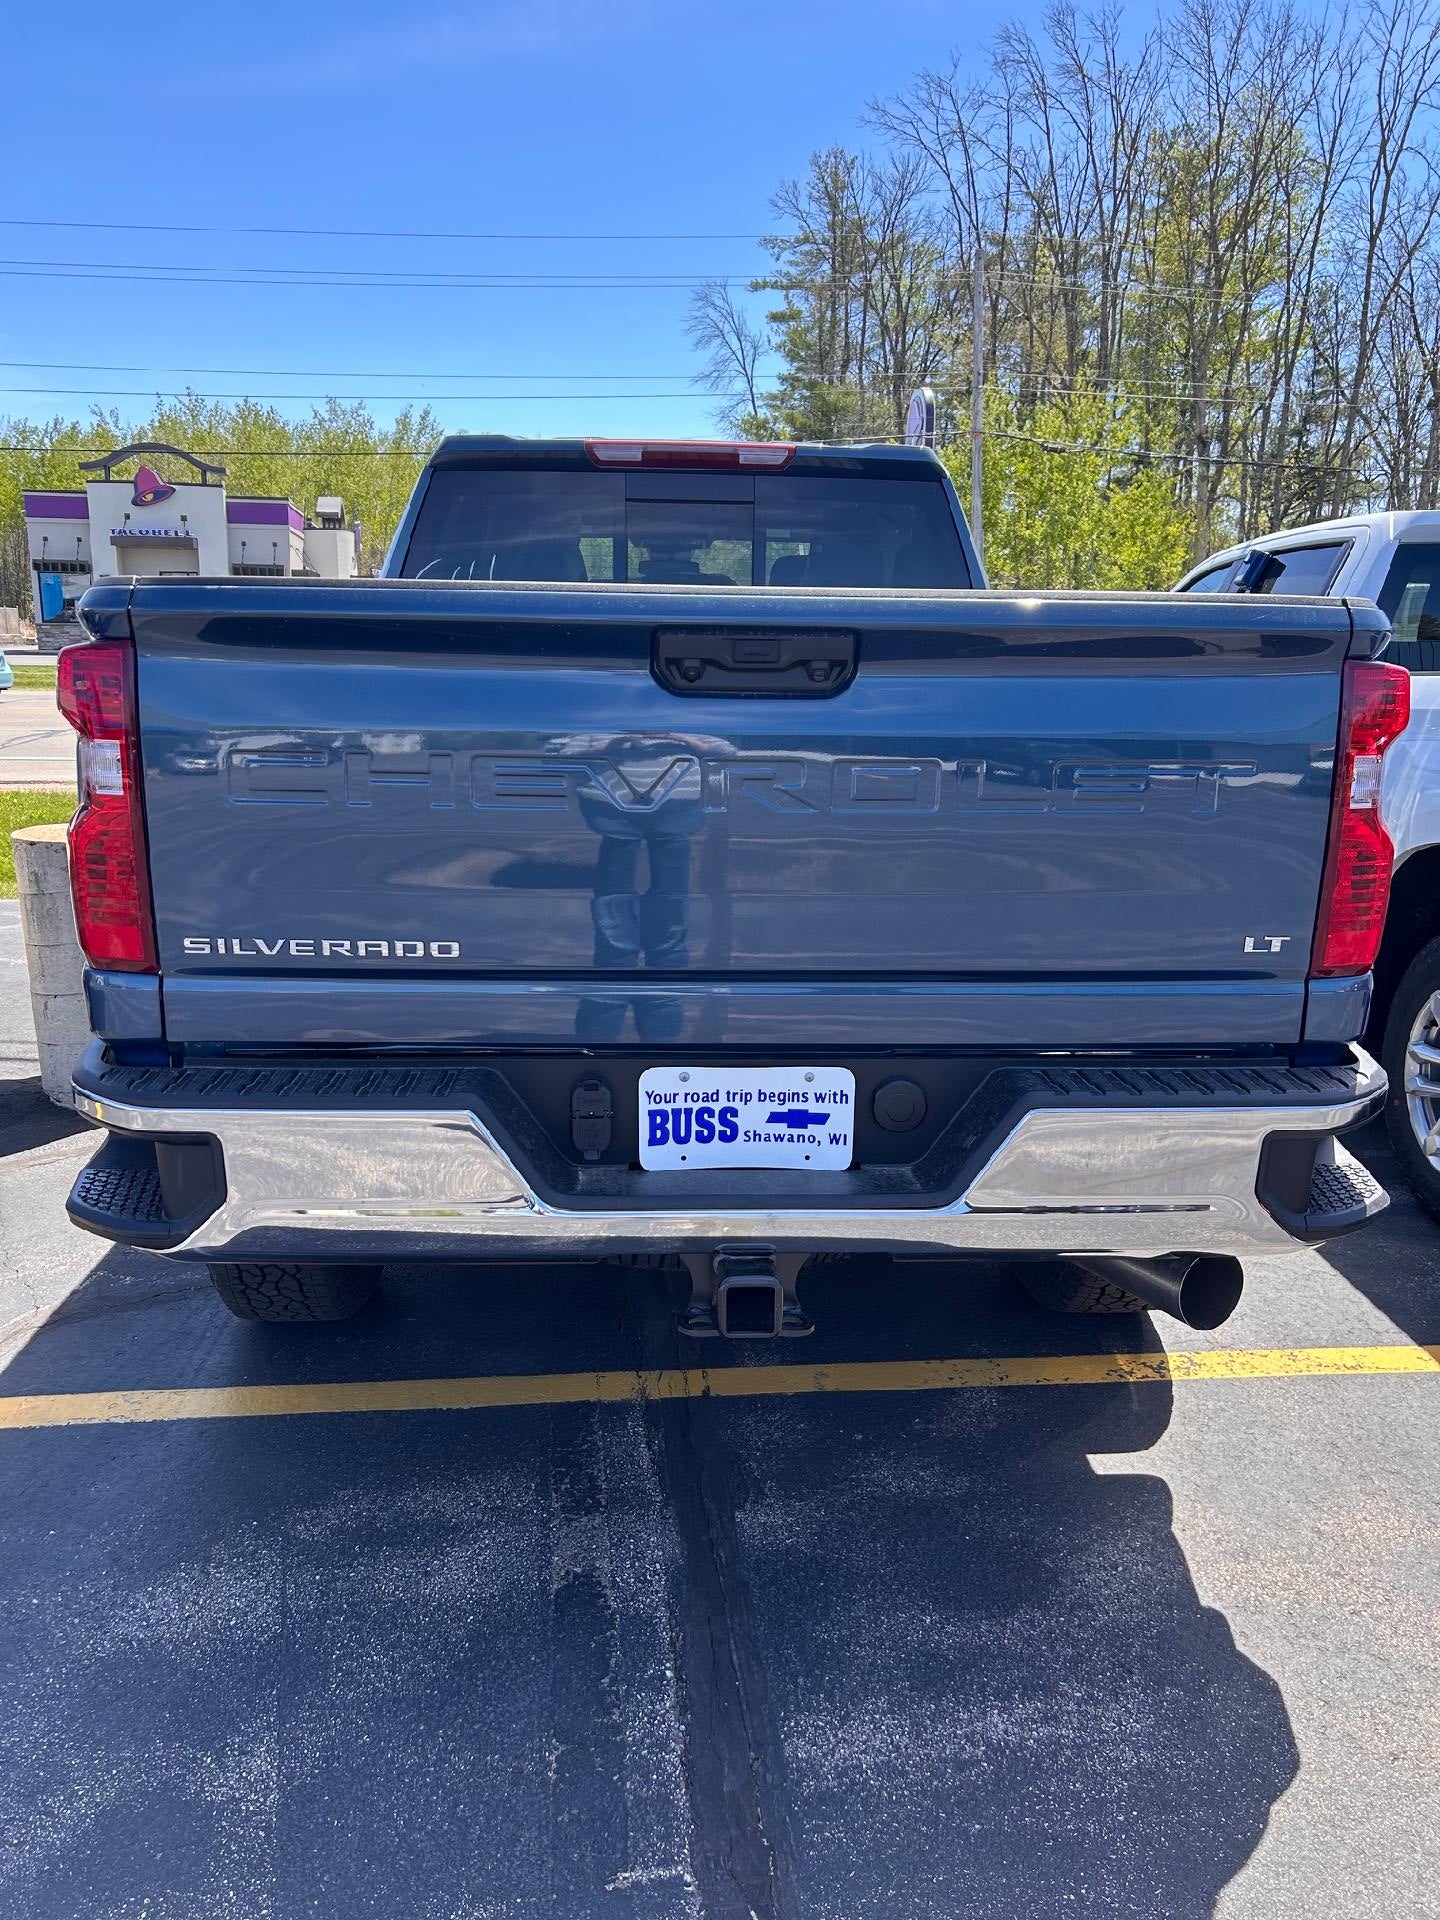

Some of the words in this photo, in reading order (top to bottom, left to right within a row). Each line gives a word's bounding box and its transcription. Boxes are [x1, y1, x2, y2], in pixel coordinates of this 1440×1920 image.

[227, 748, 1259, 814] CHEVROLET
[183, 937, 461, 958] SILVERADO
[1243, 936, 1291, 953] LT
[645, 1090, 679, 1105] Your
[684, 1089, 720, 1103] road
[726, 1090, 753, 1105] trip
[757, 1089, 809, 1105] begins
[814, 1090, 849, 1105] with
[647, 1106, 739, 1147] BUSS
[743, 1130, 821, 1146] Shawano,
[829, 1132, 848, 1146] WI
